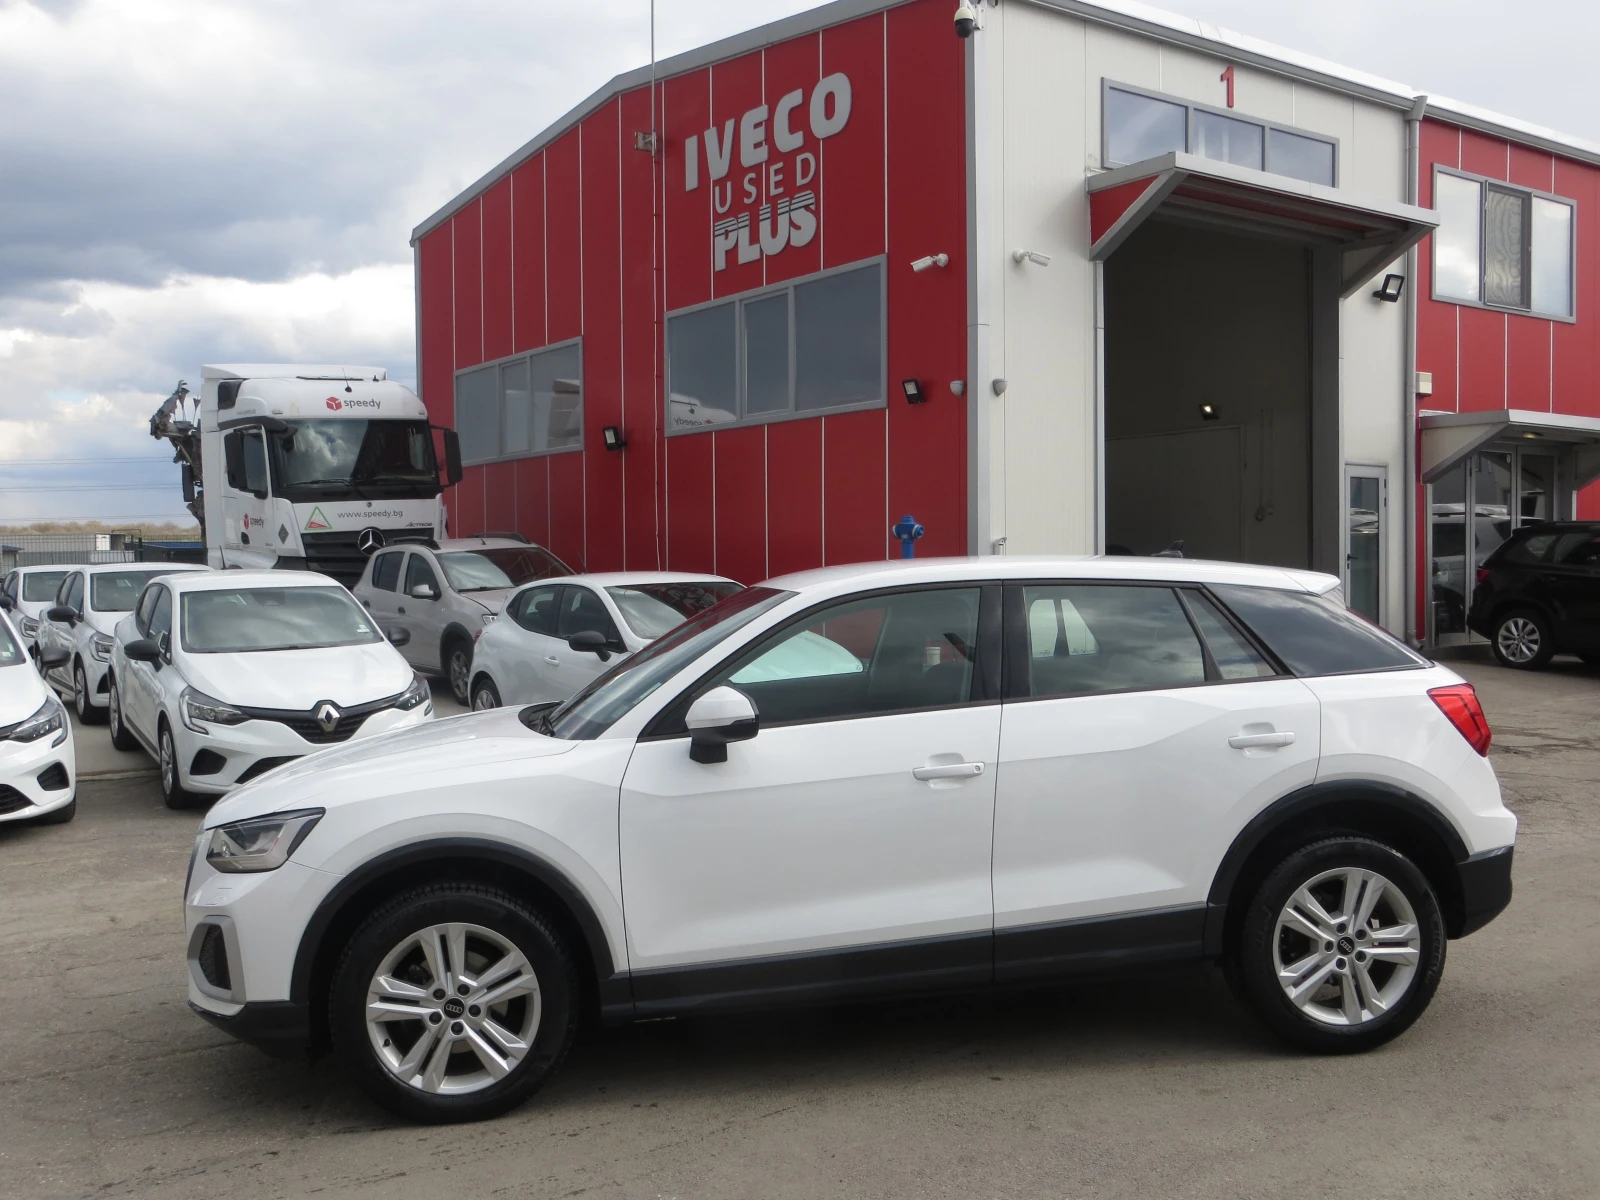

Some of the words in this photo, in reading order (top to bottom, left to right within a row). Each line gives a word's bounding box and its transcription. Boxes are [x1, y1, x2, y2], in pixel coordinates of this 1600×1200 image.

[1220, 65, 1234, 108] 1
[685, 72, 853, 192] IVECO
[715, 152, 816, 214] USED
[714, 190, 818, 272] PLUS
[343, 398, 381, 410] speedy
[337, 510, 404, 519] www.speedy.bg
